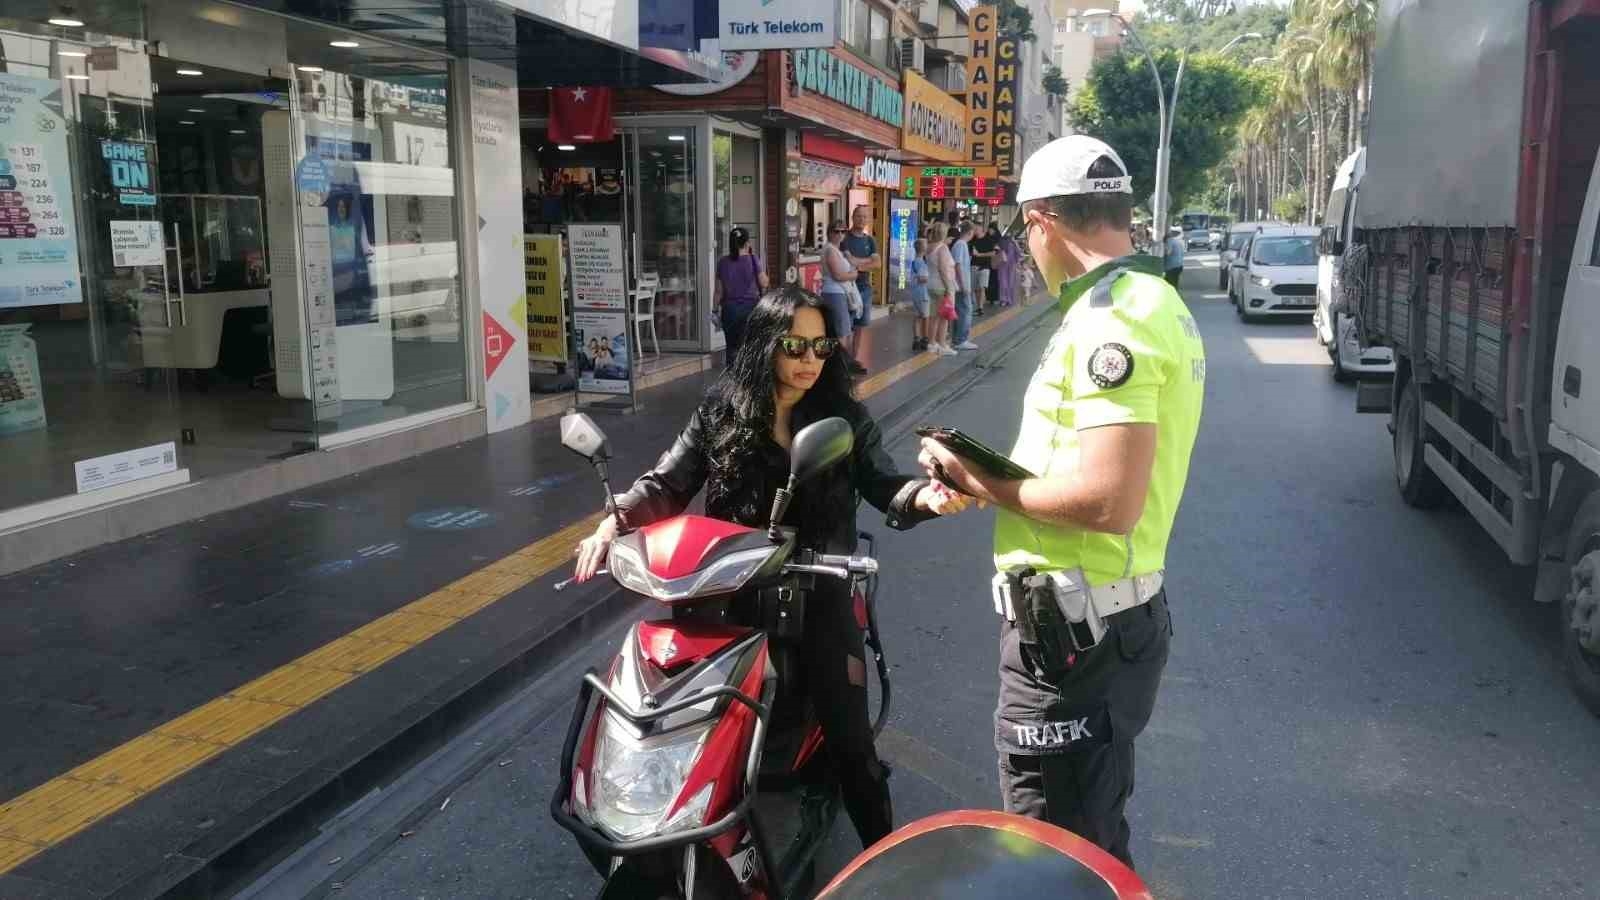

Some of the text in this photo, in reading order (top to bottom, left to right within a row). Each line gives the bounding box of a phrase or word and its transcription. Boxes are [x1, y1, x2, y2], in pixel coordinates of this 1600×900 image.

[728, 19, 824, 35] Türk Telekom
[971, 13, 989, 161] CHANGE
[995, 41, 1015, 171] CHANGE
[102, 143, 145, 161] GAME
[112, 160, 149, 188] ON
[31, 179, 47, 188] 224
[898, 208, 910, 216] NO
[48, 226, 65, 236] 328
